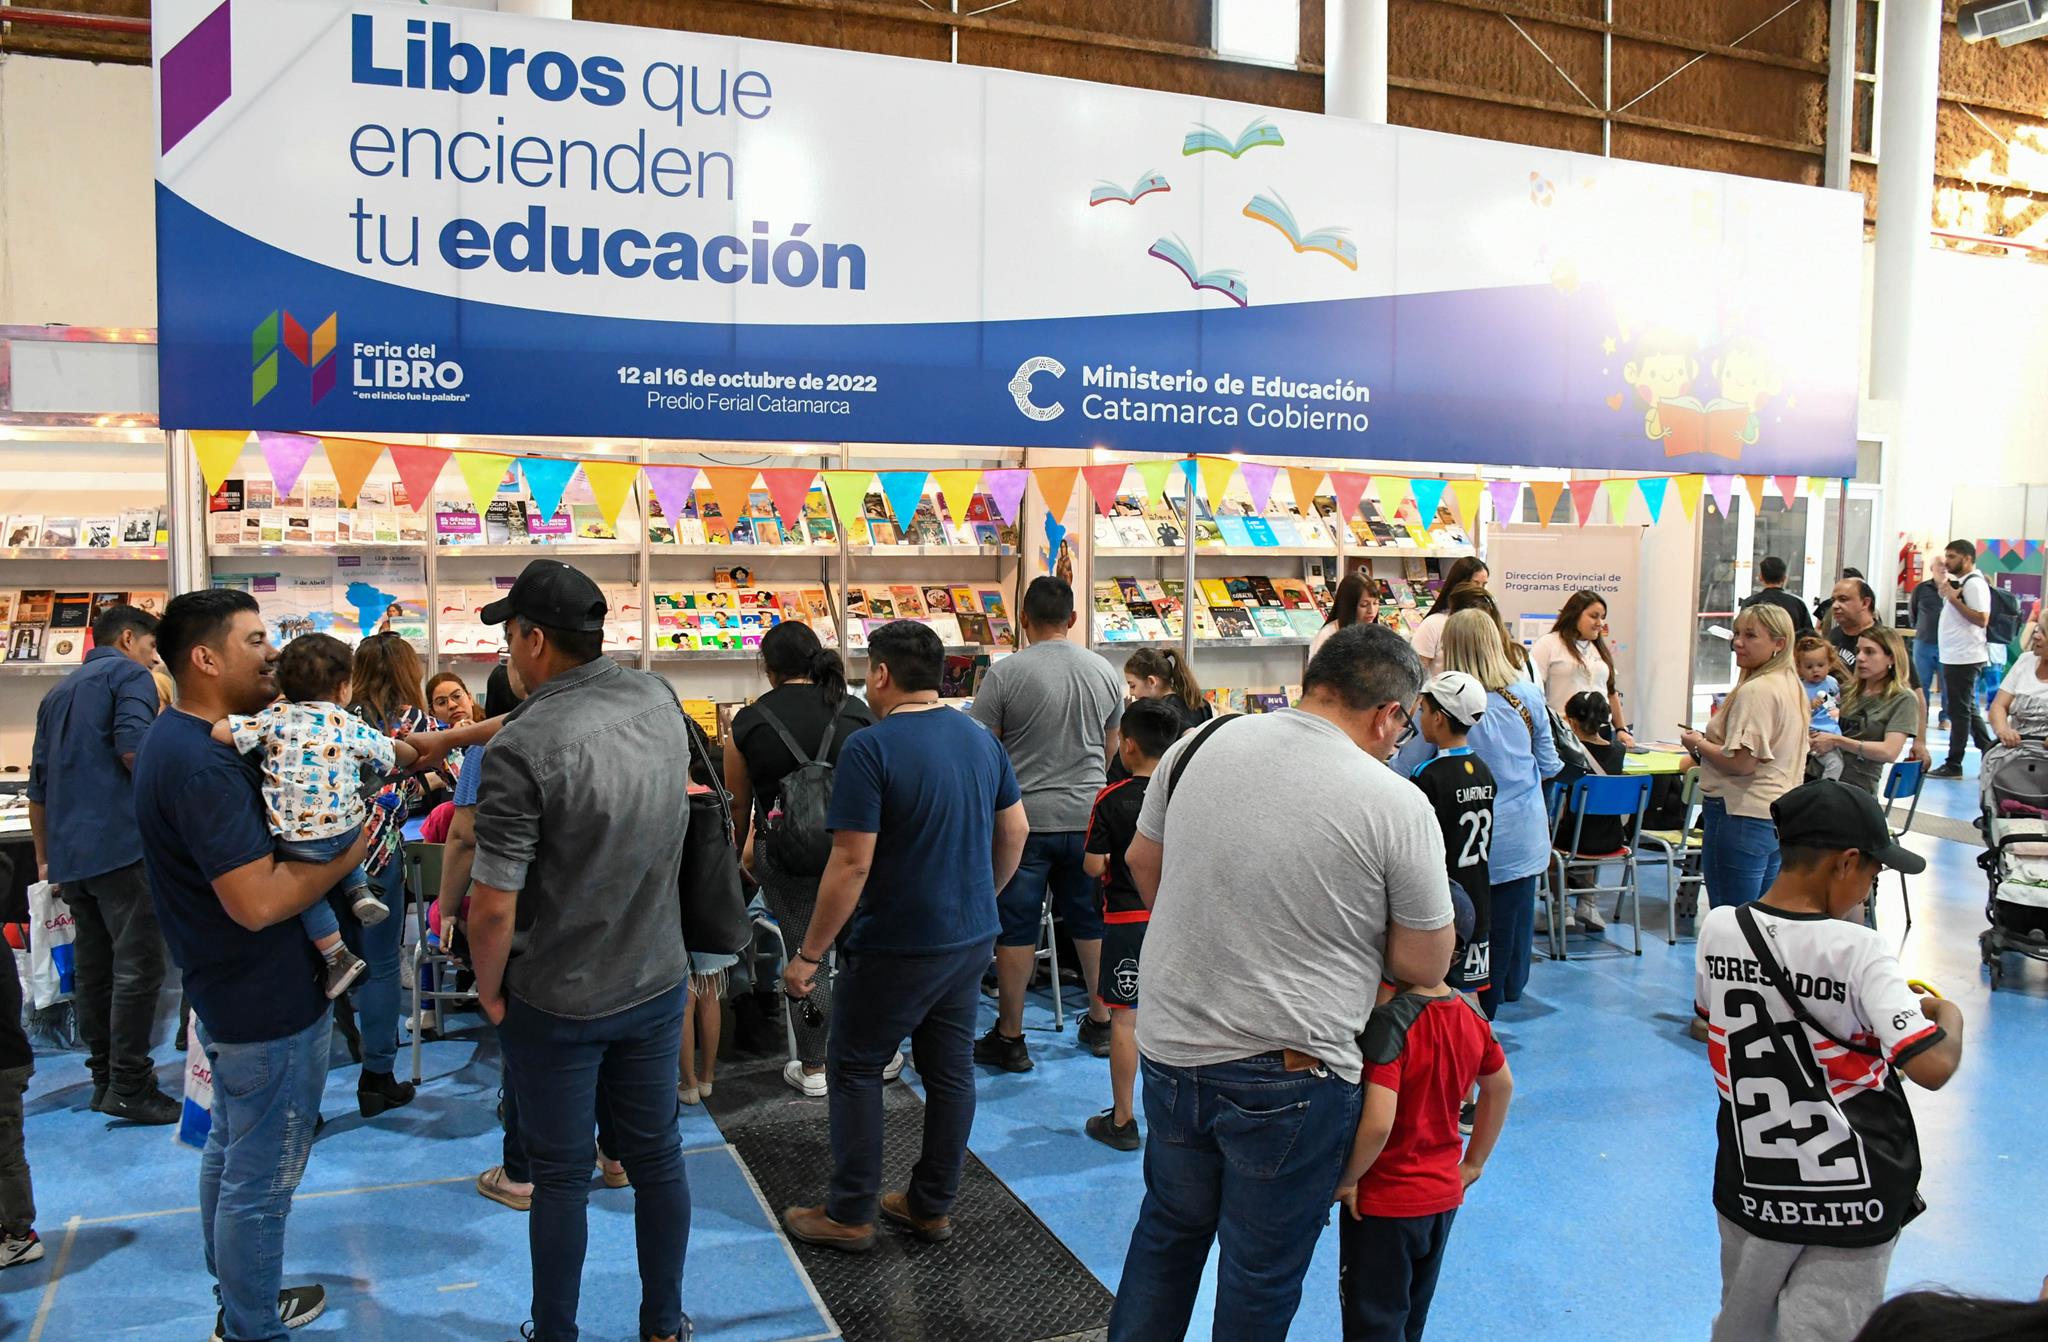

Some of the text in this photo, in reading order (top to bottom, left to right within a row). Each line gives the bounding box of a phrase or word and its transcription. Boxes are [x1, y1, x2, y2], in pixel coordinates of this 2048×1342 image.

[351, 13, 773, 127] Libros que
[350, 116, 735, 200] encienden
[349, 198, 867, 290] tu educación
[353, 341, 436, 359] Feria del
[353, 358, 464, 390] LIBRO
[617, 366, 878, 392] 12 al 16 de octubre de 2022
[1083, 364, 1370, 402] Ministerio de Educación
[372, 392, 380, 400] el
[381, 391, 405, 400] inicio
[406, 392, 422, 401] fue
[422, 393, 431, 401] la
[648, 391, 851, 414] Predio Ferial Catamarca
[1083, 394, 1369, 432] Catamarca Gobierno
[1505, 571, 1553, 580] Dirección
[1556, 572, 1606, 581] Provincial
[1505, 582, 1619, 592] Programas Educativos
[1458, 808, 1493, 869] 23
[1735, 1076, 1860, 1182] 22
[1738, 1193, 1884, 1227] PABLITO
